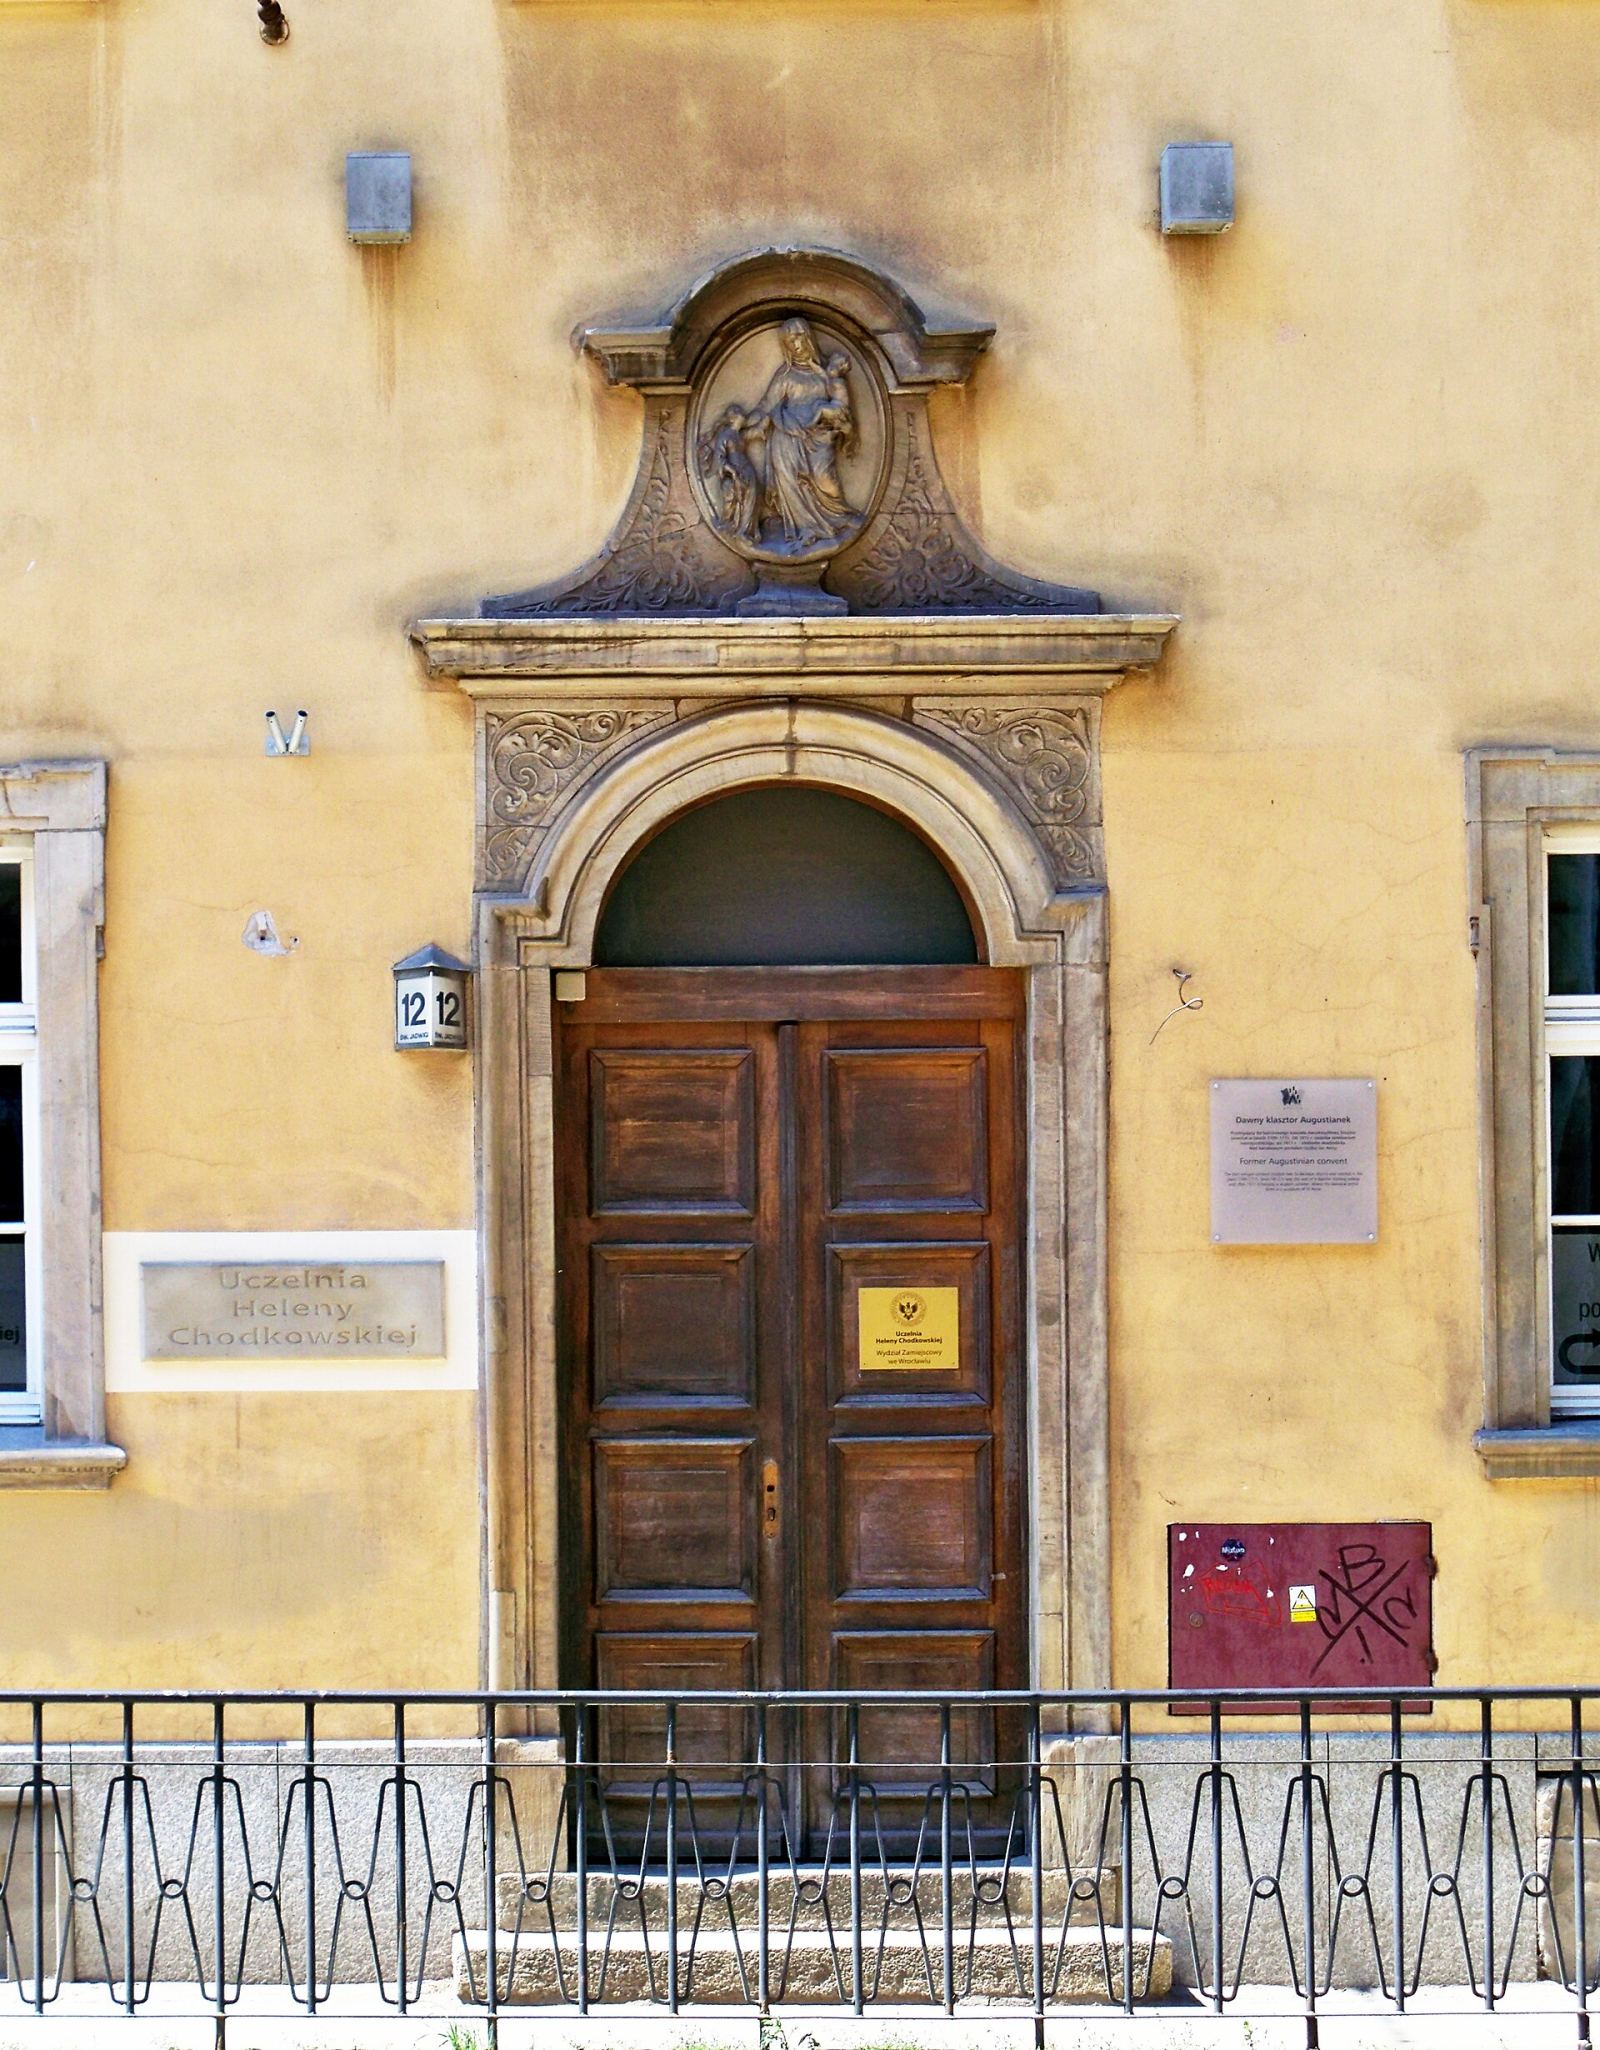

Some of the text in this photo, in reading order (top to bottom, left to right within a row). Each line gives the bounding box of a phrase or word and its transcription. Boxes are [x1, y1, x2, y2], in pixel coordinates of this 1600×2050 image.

[401, 991, 427, 1027] 12
[436, 991, 461, 1027] 12
[1235, 1115, 1351, 1126] Dawny klasztor Augustianek
[1239, 1157, 1348, 1167] Former Augustinian convent
[218, 1269, 369, 1291] Uczelnia
[232, 1299, 354, 1321] Heleny
[168, 1324, 420, 1348] Chodkowskiej
